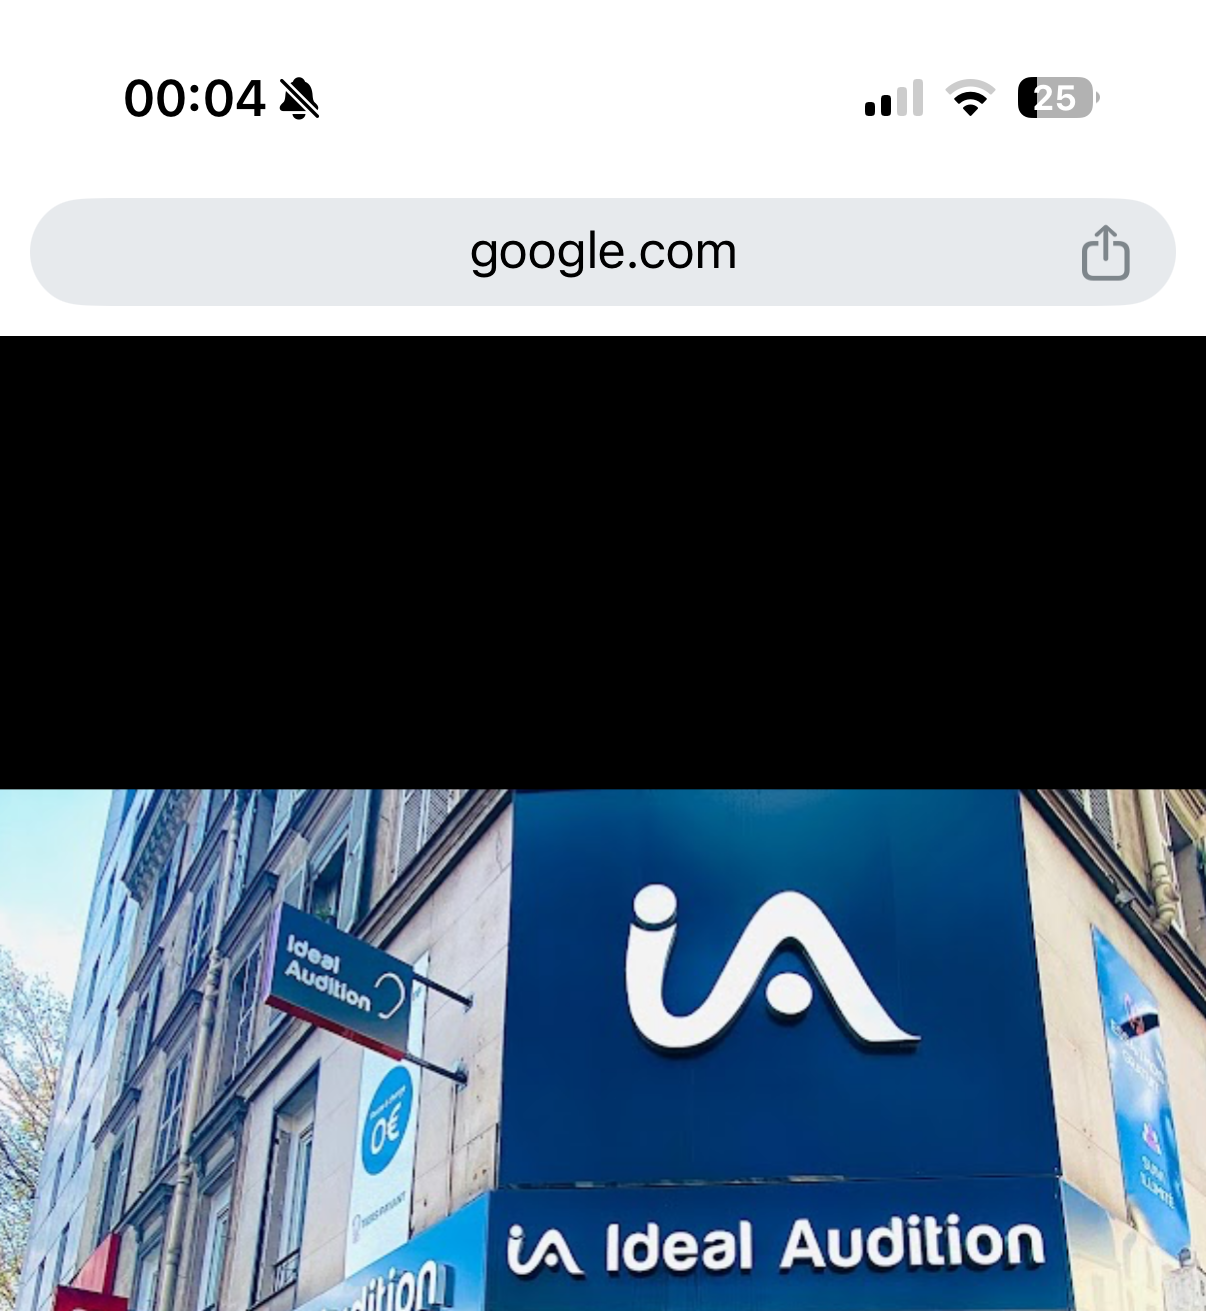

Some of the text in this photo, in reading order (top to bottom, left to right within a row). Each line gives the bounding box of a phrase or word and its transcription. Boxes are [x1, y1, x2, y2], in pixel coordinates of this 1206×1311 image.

[286, 934, 340, 974] Ideal
[284, 960, 371, 1012] Audition
[371, 1101, 402, 1155] 0€
[606, 1219, 753, 1273] Ideal
[779, 1213, 1046, 1269] Audition
